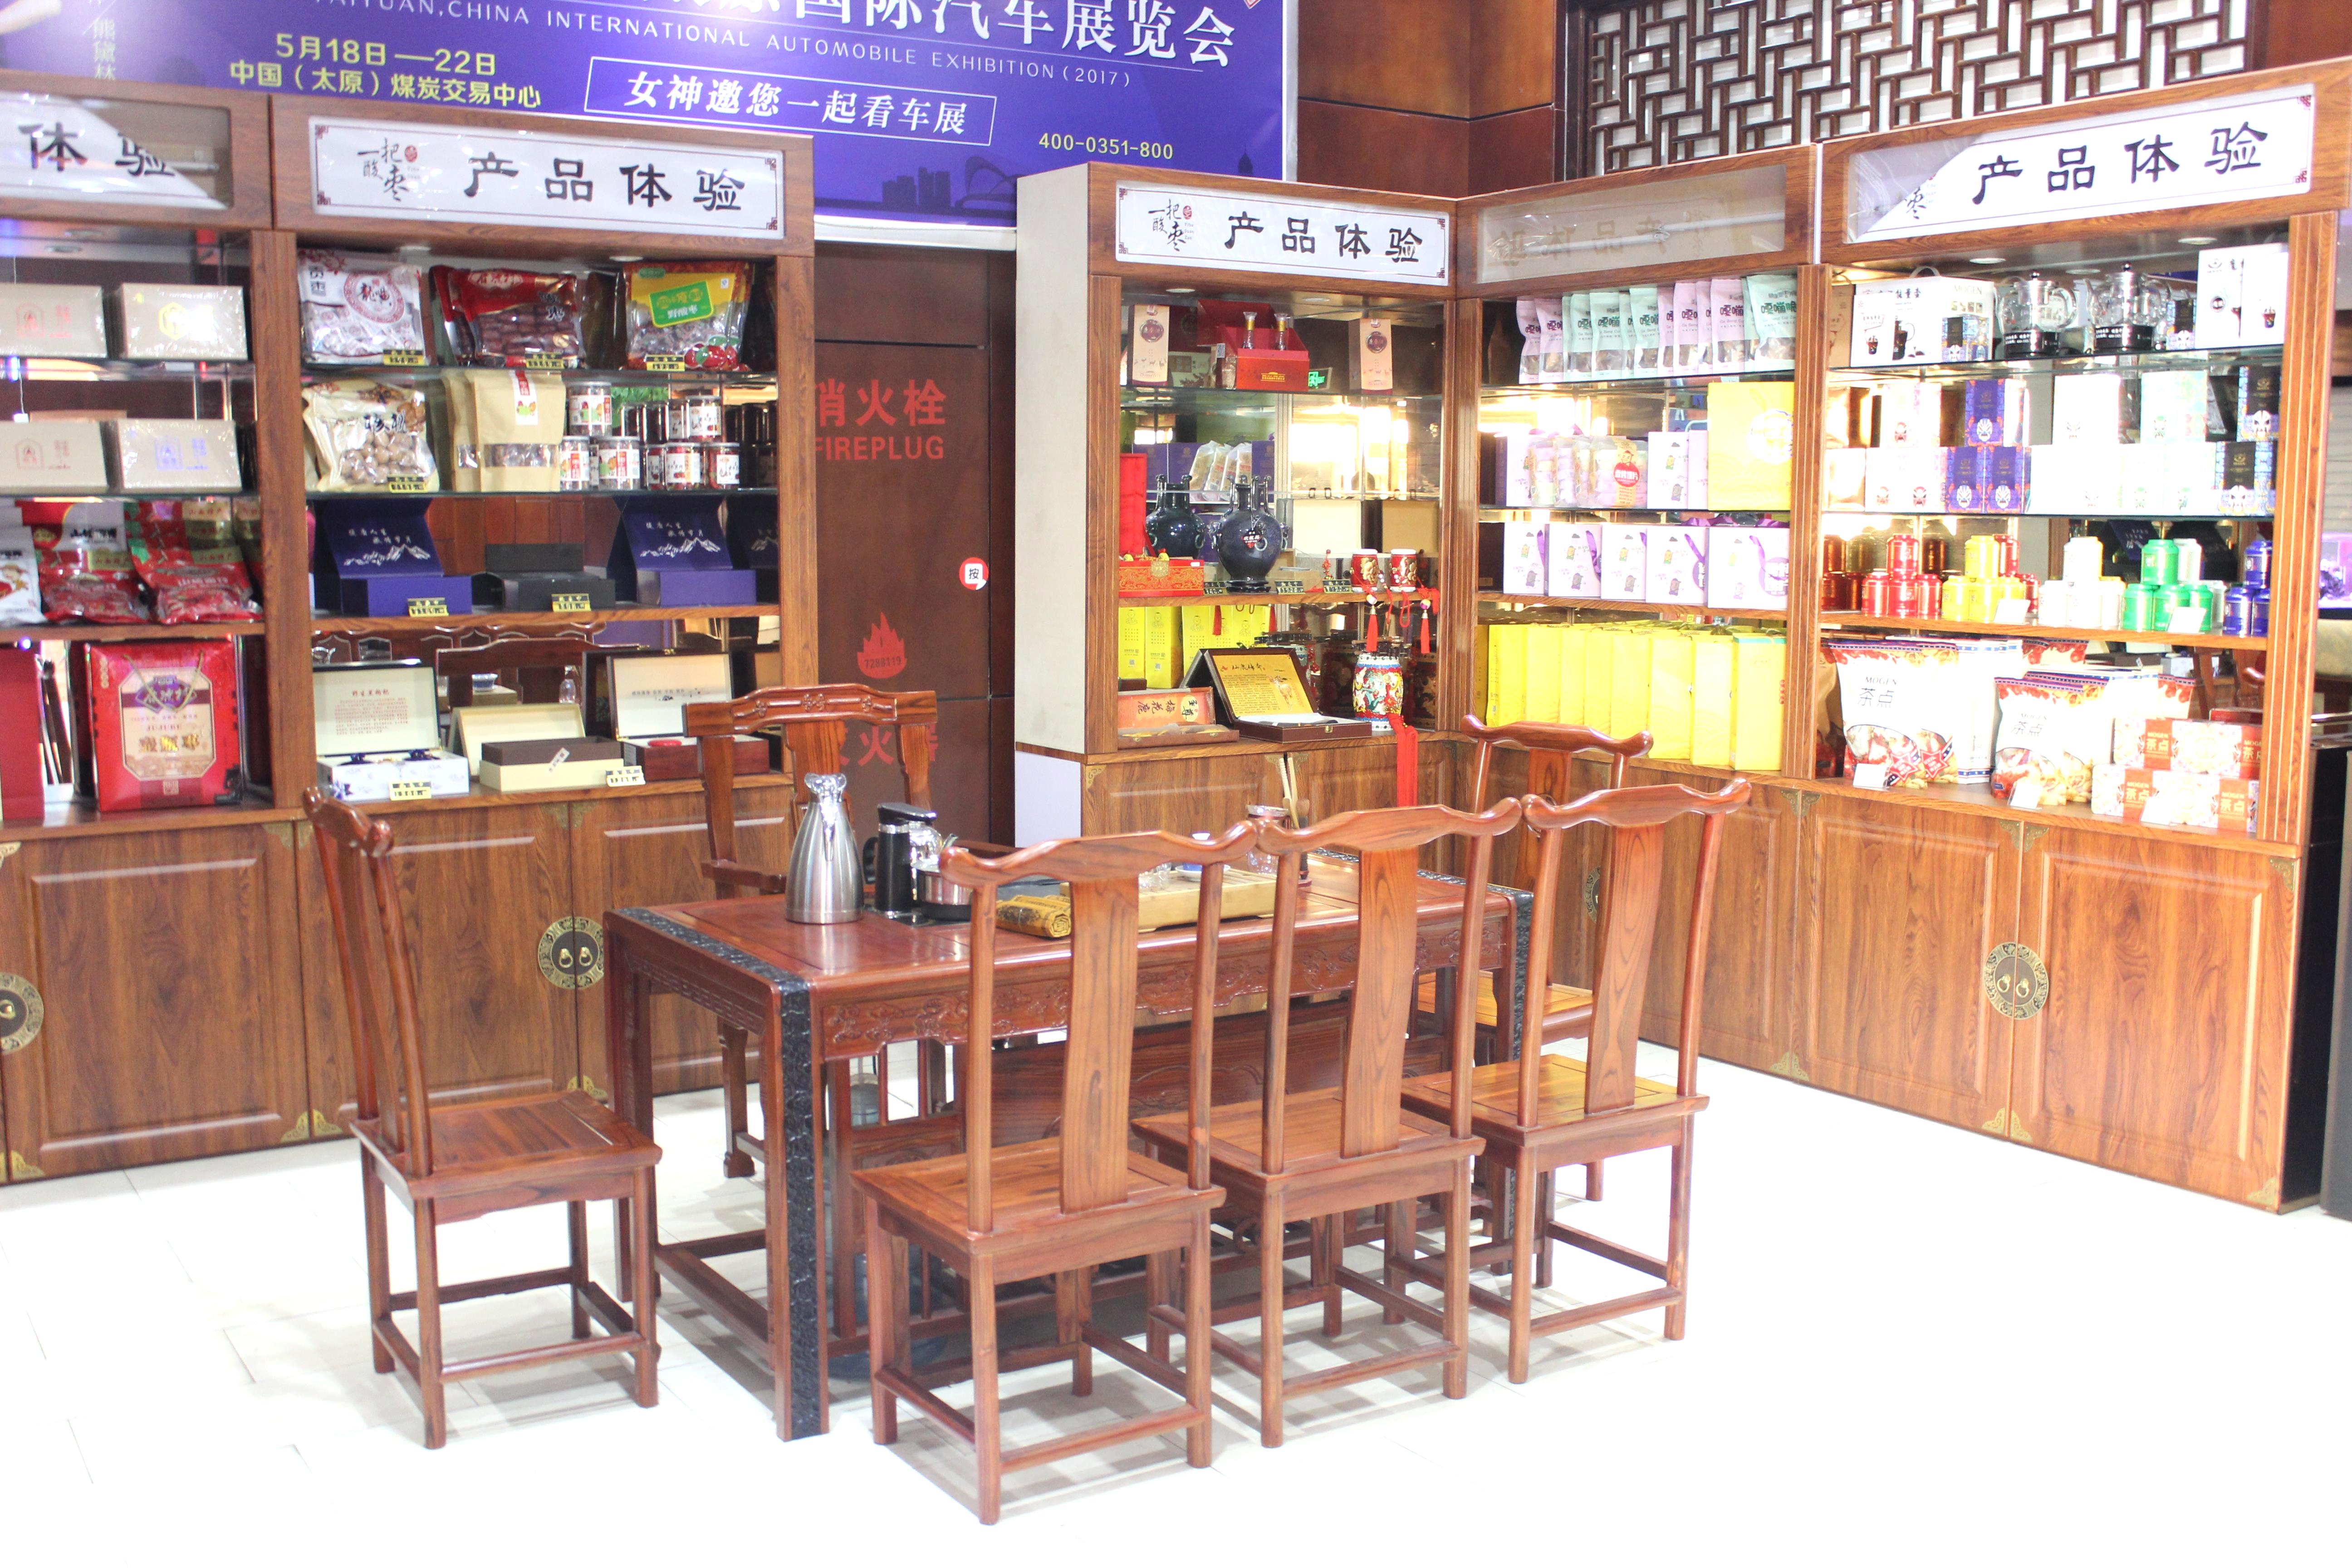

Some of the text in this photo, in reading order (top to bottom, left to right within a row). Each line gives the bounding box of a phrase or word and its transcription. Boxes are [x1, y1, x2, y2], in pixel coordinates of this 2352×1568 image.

[547, 10, 750, 47] INTERNATIONAL
[766, 34, 916, 64] AUTOMOBILE
[932, 52, 1054, 79] EXHIBITION
[623, 71, 967, 136] 女神邀您一起看车展
[1039, 132, 1174, 160] 400-0351-800
[1972, 120, 2269, 205] 产品体验
[463, 151, 745, 212] 产品体验
[1225, 211, 1422, 264] 产品体验
[815, 378, 946, 427] 消火栓
[969, 568, 980, 579] 按
[1857, 687, 1895, 708] 茶点
[2146, 739, 2169, 752] 茶点
[2126, 788, 2150, 801] 茶点
[2220, 799, 2245, 812] 茶点
